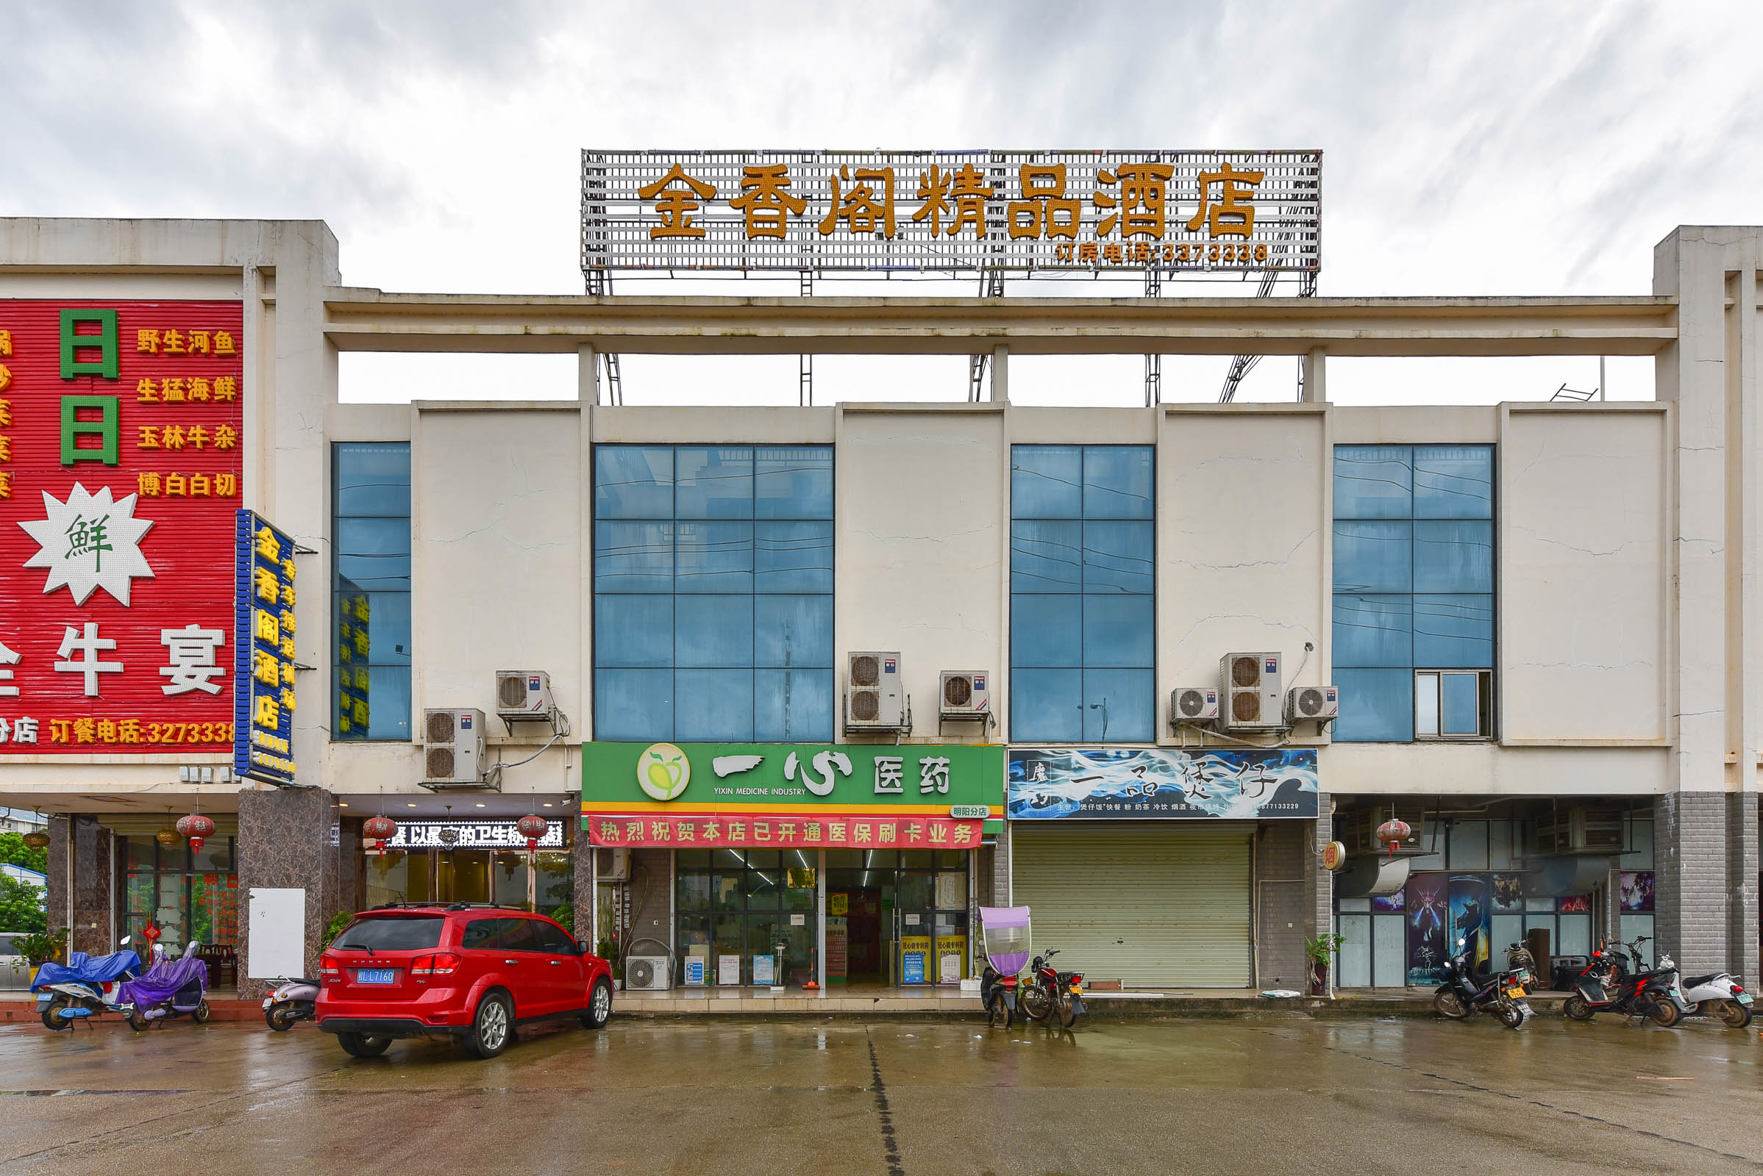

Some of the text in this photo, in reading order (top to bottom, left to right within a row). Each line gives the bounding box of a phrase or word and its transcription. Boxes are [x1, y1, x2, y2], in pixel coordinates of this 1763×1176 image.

[637, 162, 1265, 240] 金香阁精品酒店
[137, 329, 237, 355] 野生河鱼
[136, 376, 237, 402] 生猛海鲜
[137, 424, 238, 450] 玉林牛杂
[137, 472, 236, 497] 博白白切
[255, 526, 280, 731] 金香阁酒店
[713, 787, 806, 796] YIXIN MEDICINE INDUSTRY
[953, 807, 987, 816] 明阳分店
[600, 819, 973, 844] 热烈祝贺本店已开通医保刷卡业务
